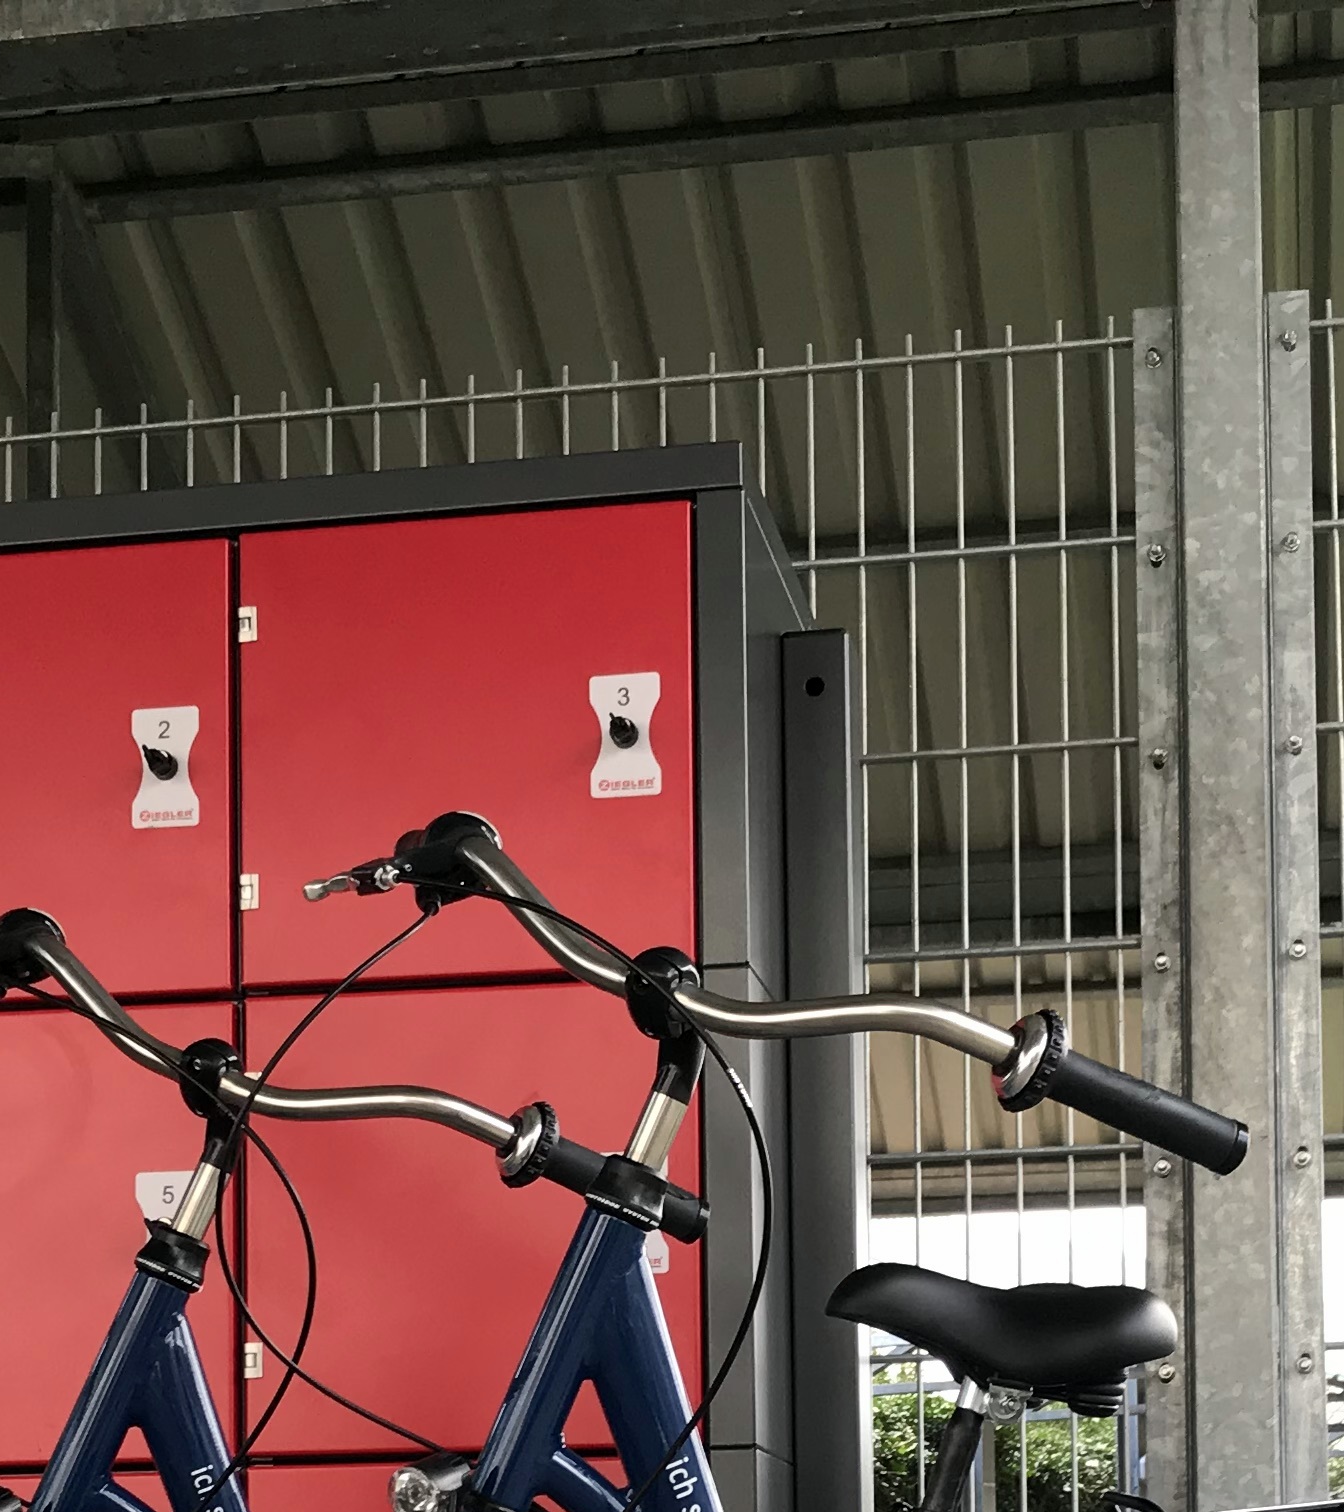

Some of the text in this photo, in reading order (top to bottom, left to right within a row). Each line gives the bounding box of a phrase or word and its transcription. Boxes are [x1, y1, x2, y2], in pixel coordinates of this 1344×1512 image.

[617, 687, 631, 706] 3
[158, 720, 171, 739] 2
[598, 777, 656, 791] ZIEGLER
[139, 808, 194, 822] ZIEGLER
[162, 1185, 175, 1204] 5
[665, 1456, 699, 1500] ich
